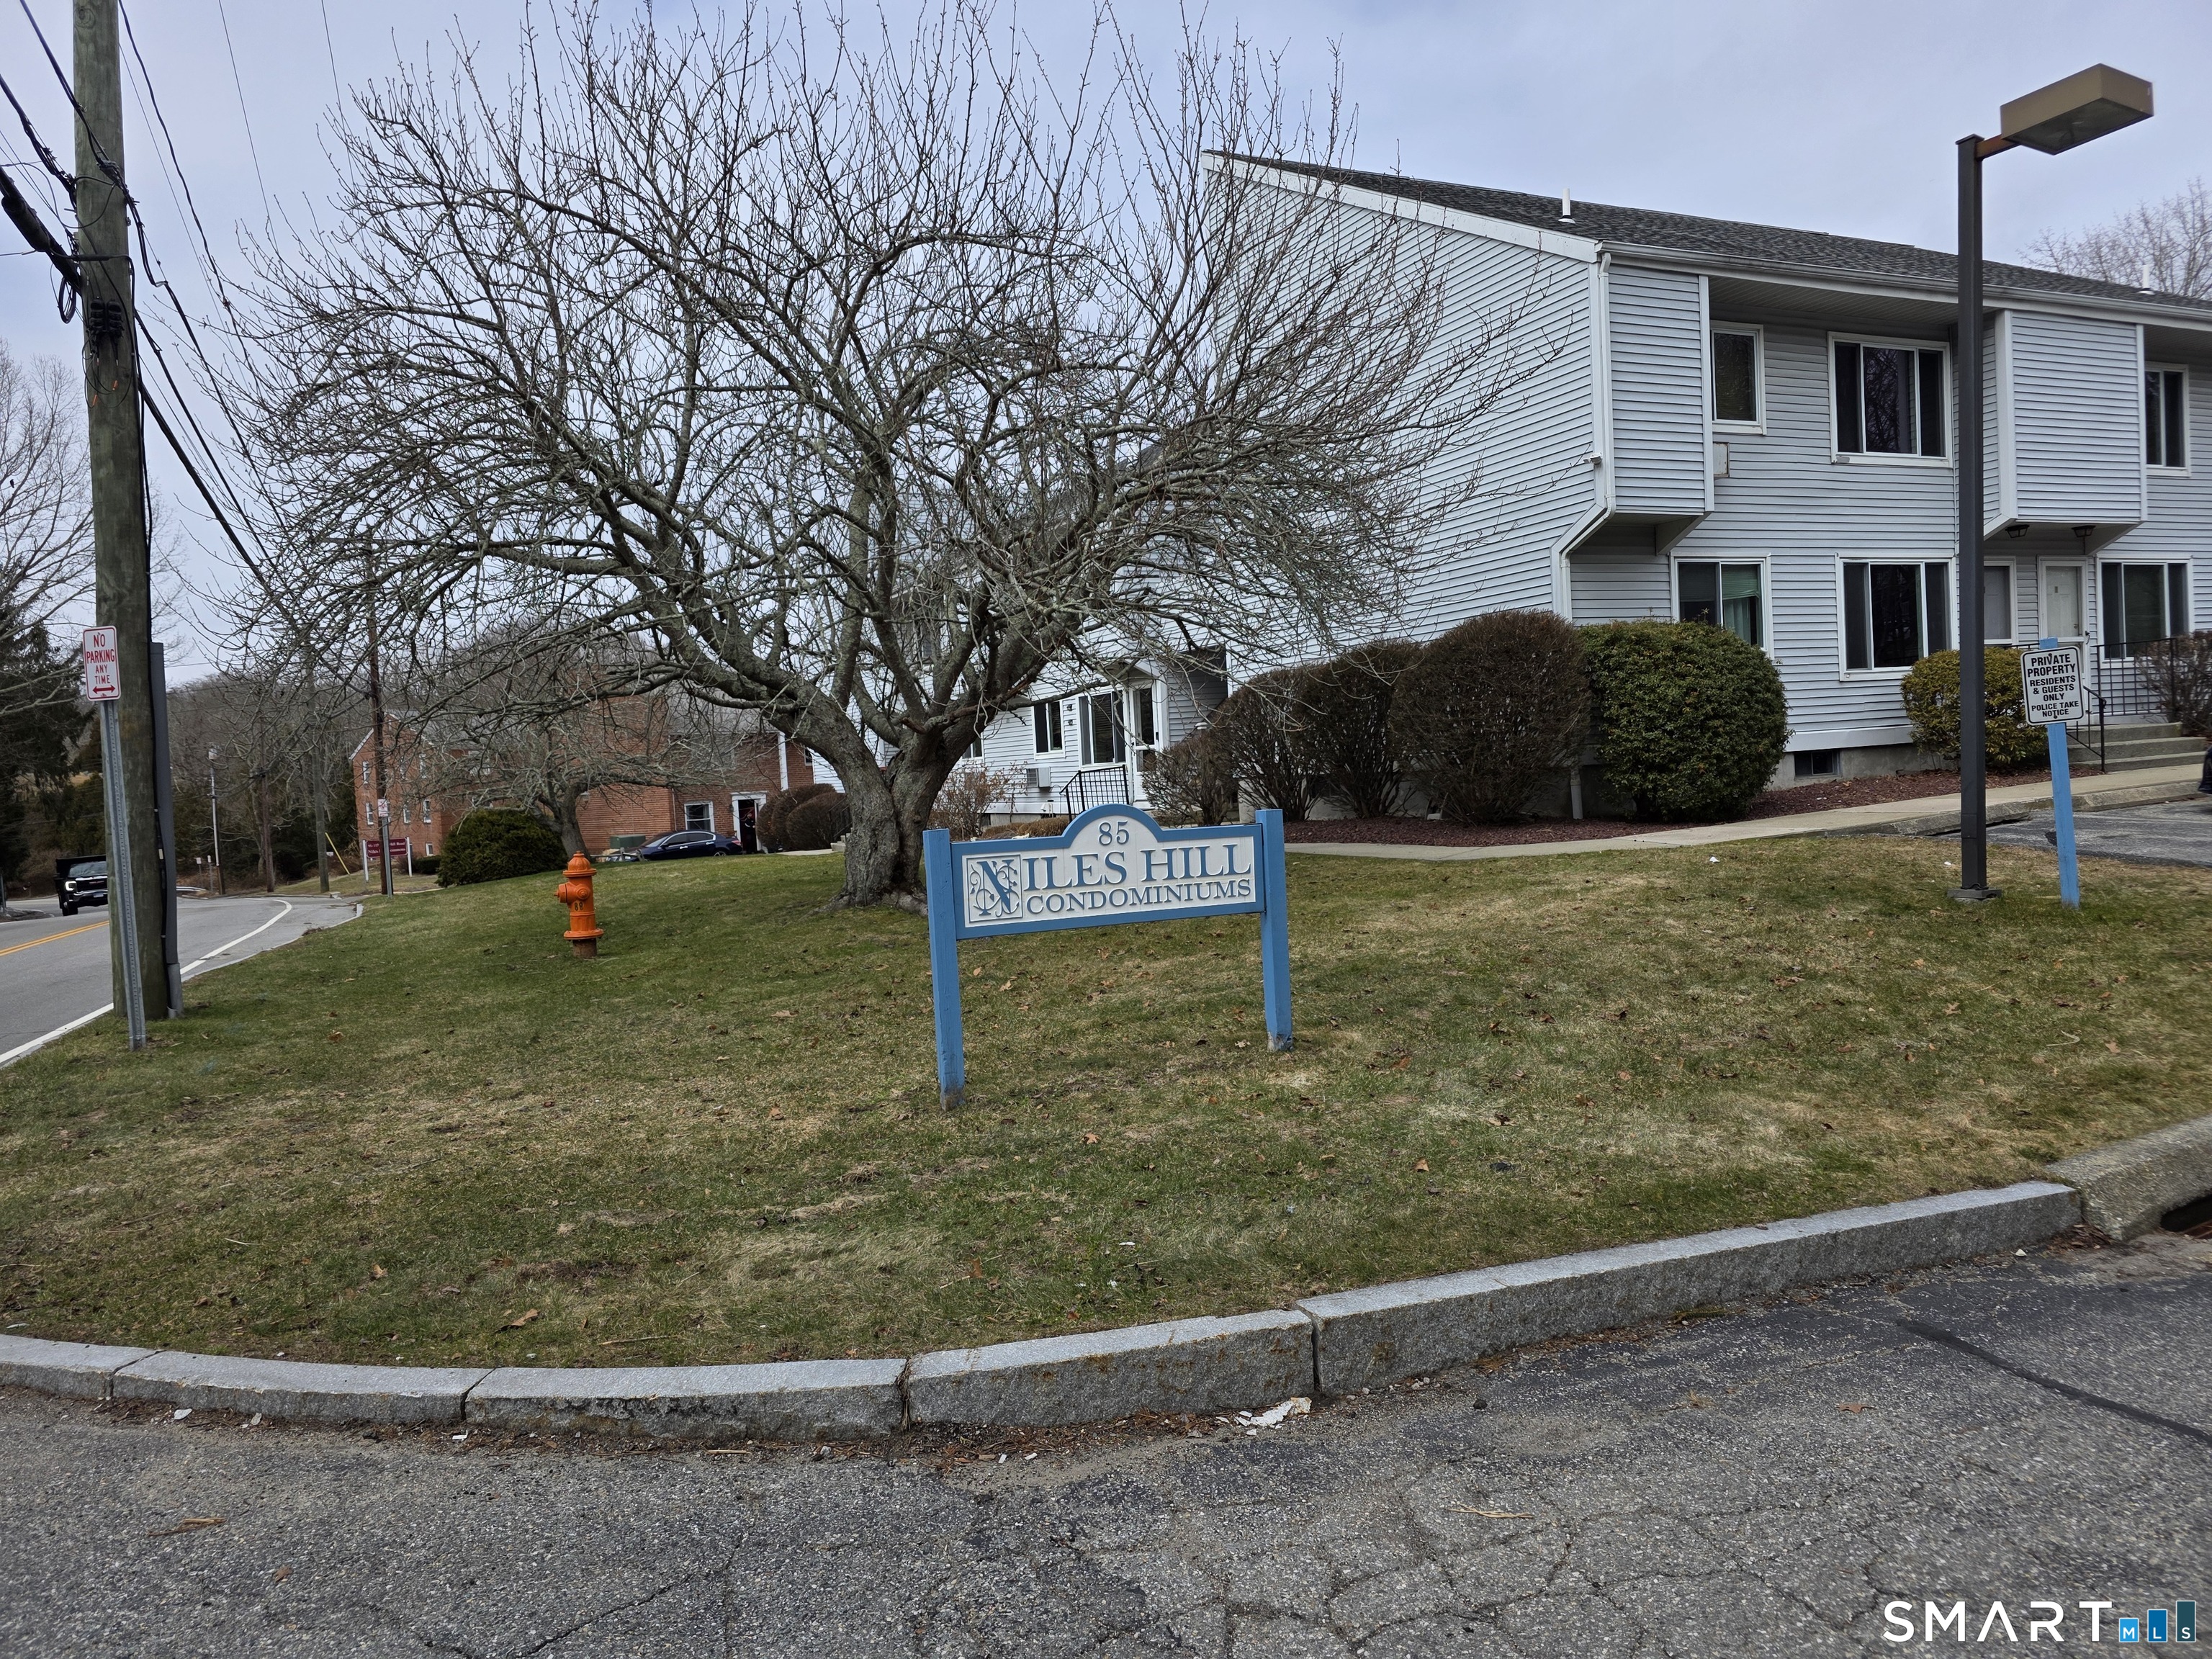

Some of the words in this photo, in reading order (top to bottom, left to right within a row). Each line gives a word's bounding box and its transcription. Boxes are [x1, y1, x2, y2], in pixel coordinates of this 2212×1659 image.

[94, 634, 106, 647] NO
[86, 649, 115, 664] PARKING
[2031, 653, 2071, 667] PRIVATE
[95, 664, 108, 674] ANY
[2027, 663, 2076, 678] PROPERTY
[94, 675, 111, 685] TIME
[2029, 675, 2076, 687] RESIDENTS
[2042, 683, 2074, 694] GUESTS
[2043, 693, 2065, 702] ONLY
[2031, 703, 2058, 711] POLICE
[2059, 700, 2080, 709] TAKE
[2042, 709, 2069, 717] NOTICE
[1098, 820, 1130, 846] 85
[976, 851, 1128, 917] NILES
[1140, 843, 1251, 883] HILL
[1025, 878, 1251, 914] CONDOMINIUMS
